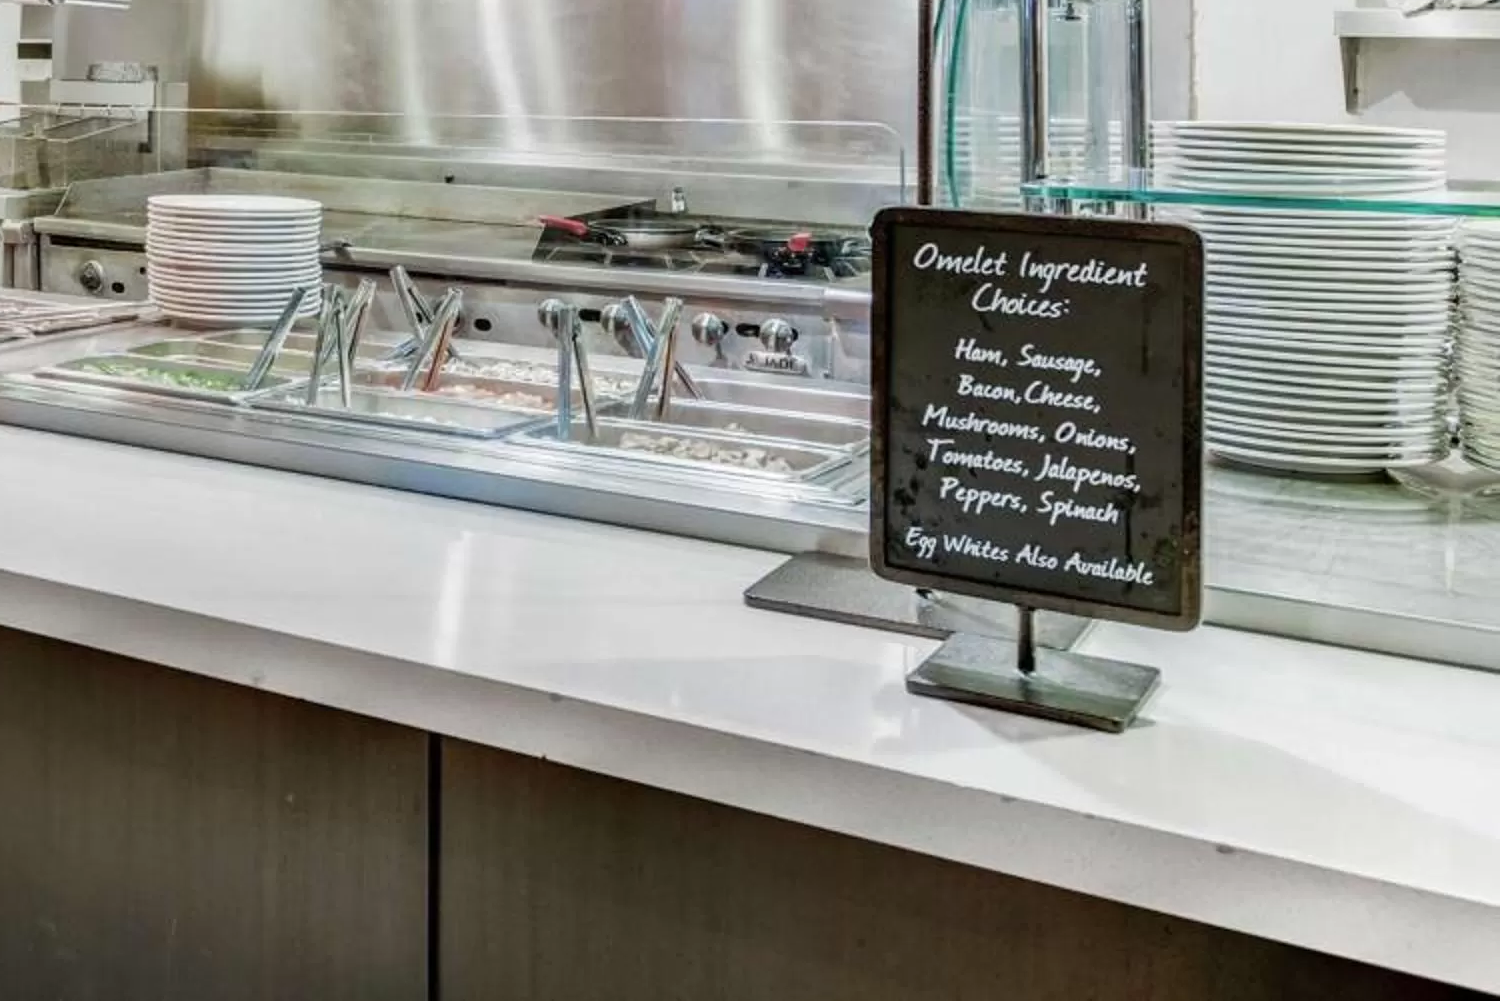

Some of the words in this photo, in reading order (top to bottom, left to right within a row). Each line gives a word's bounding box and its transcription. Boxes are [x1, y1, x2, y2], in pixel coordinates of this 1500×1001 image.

[913, 243, 1007, 276] Omelet
[1019, 252, 1147, 293] Ingredient
[971, 283, 1070, 318] Choices:
[954, 339, 1008, 366] Ham,
[1016, 344, 1102, 383] Sausage,
[921, 404, 1045, 443] Mushrooms,
[1054, 422, 1137, 454] Onions,
[927, 439, 1029, 477] Tomatoes,
[1034, 454, 1141, 492] Jalapenos,
[940, 477, 1028, 514] Peppers,
[1037, 491, 1119, 524] Spinach
[905, 526, 937, 558] Egg
[944, 534, 1009, 562] Whites
[1015, 544, 1057, 570] Also
[1063, 553, 1154, 586] Available
